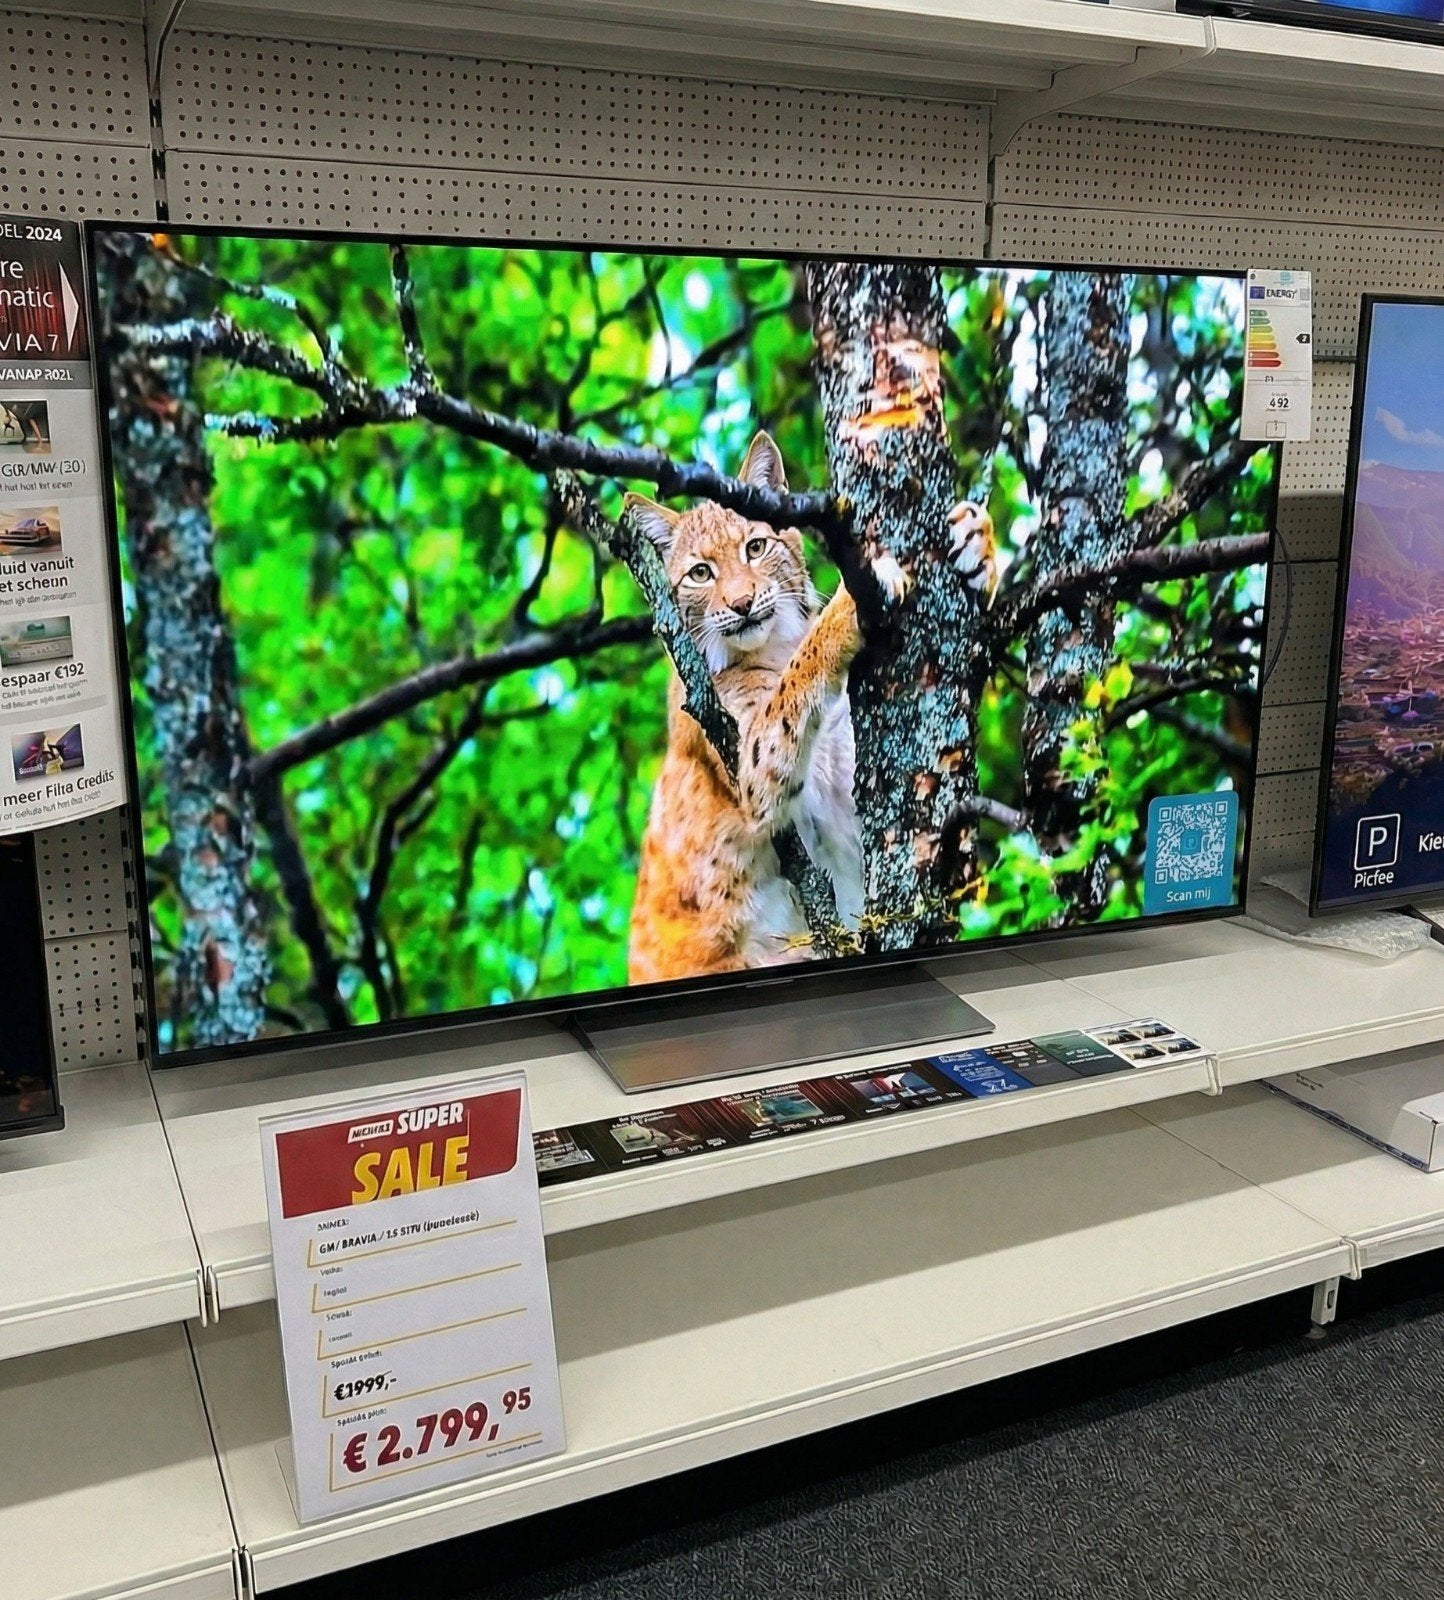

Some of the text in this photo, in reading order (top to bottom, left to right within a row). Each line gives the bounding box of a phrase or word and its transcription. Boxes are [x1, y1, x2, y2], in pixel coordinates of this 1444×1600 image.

[25, 226, 63, 242] 2024
[0, 260, 24, 278] re
[48, 333, 59, 352] 7
[30, 556, 75, 572] vanuit
[0, 670, 51, 689] espaar
[55, 662, 85, 683] €192
[3, 789, 42, 807] meer
[77, 769, 115, 790] Credits
[1368, 826, 1388, 857] P
[1418, 832, 1444, 853] Kie
[1354, 869, 1394, 888] Picfee
[1166, 890, 1192, 902] Scan
[396, 1102, 464, 1135] SUPER
[352, 1135, 470, 1206] SALE
[342, 1233, 377, 1249] BRAVIA
